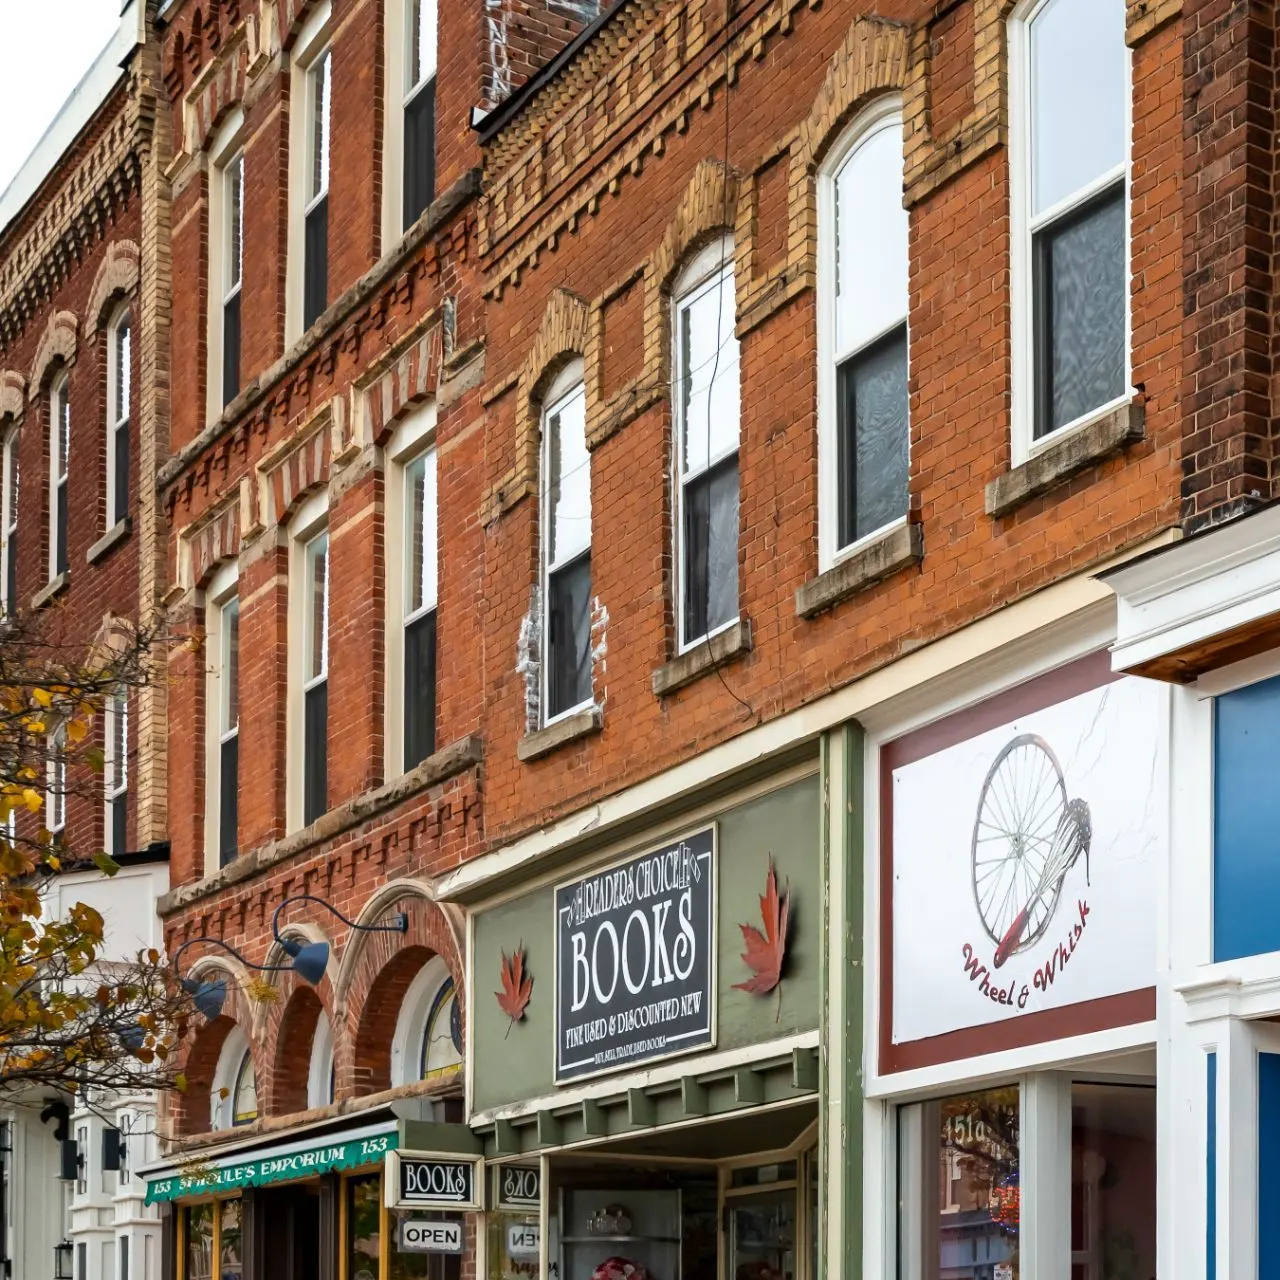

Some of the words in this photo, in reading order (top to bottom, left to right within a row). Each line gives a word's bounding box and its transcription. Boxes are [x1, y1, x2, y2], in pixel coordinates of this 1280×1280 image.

[585, 865, 634, 918] READERS
[636, 848, 679, 900] CHOICE
[571, 887, 696, 1012] BOOKS
[962, 943, 1014, 1005] Wheel
[1018, 984, 1029, 1008] &
[1033, 899, 1090, 991] Whisk
[566, 1026, 583, 1049] FINE
[584, 1018, 607, 1043] USED
[609, 1016, 616, 1036] &
[617, 998, 679, 1034] DISCOUNTED
[681, 991, 702, 1017] NEW
[154, 1180, 171, 1194] 153
[260, 1146, 345, 1176] EMPORIUM
[361, 1136, 389, 1156] 153
[405, 1164, 466, 1193] BOOKS
[406, 1228, 458, 1244] OPEN
